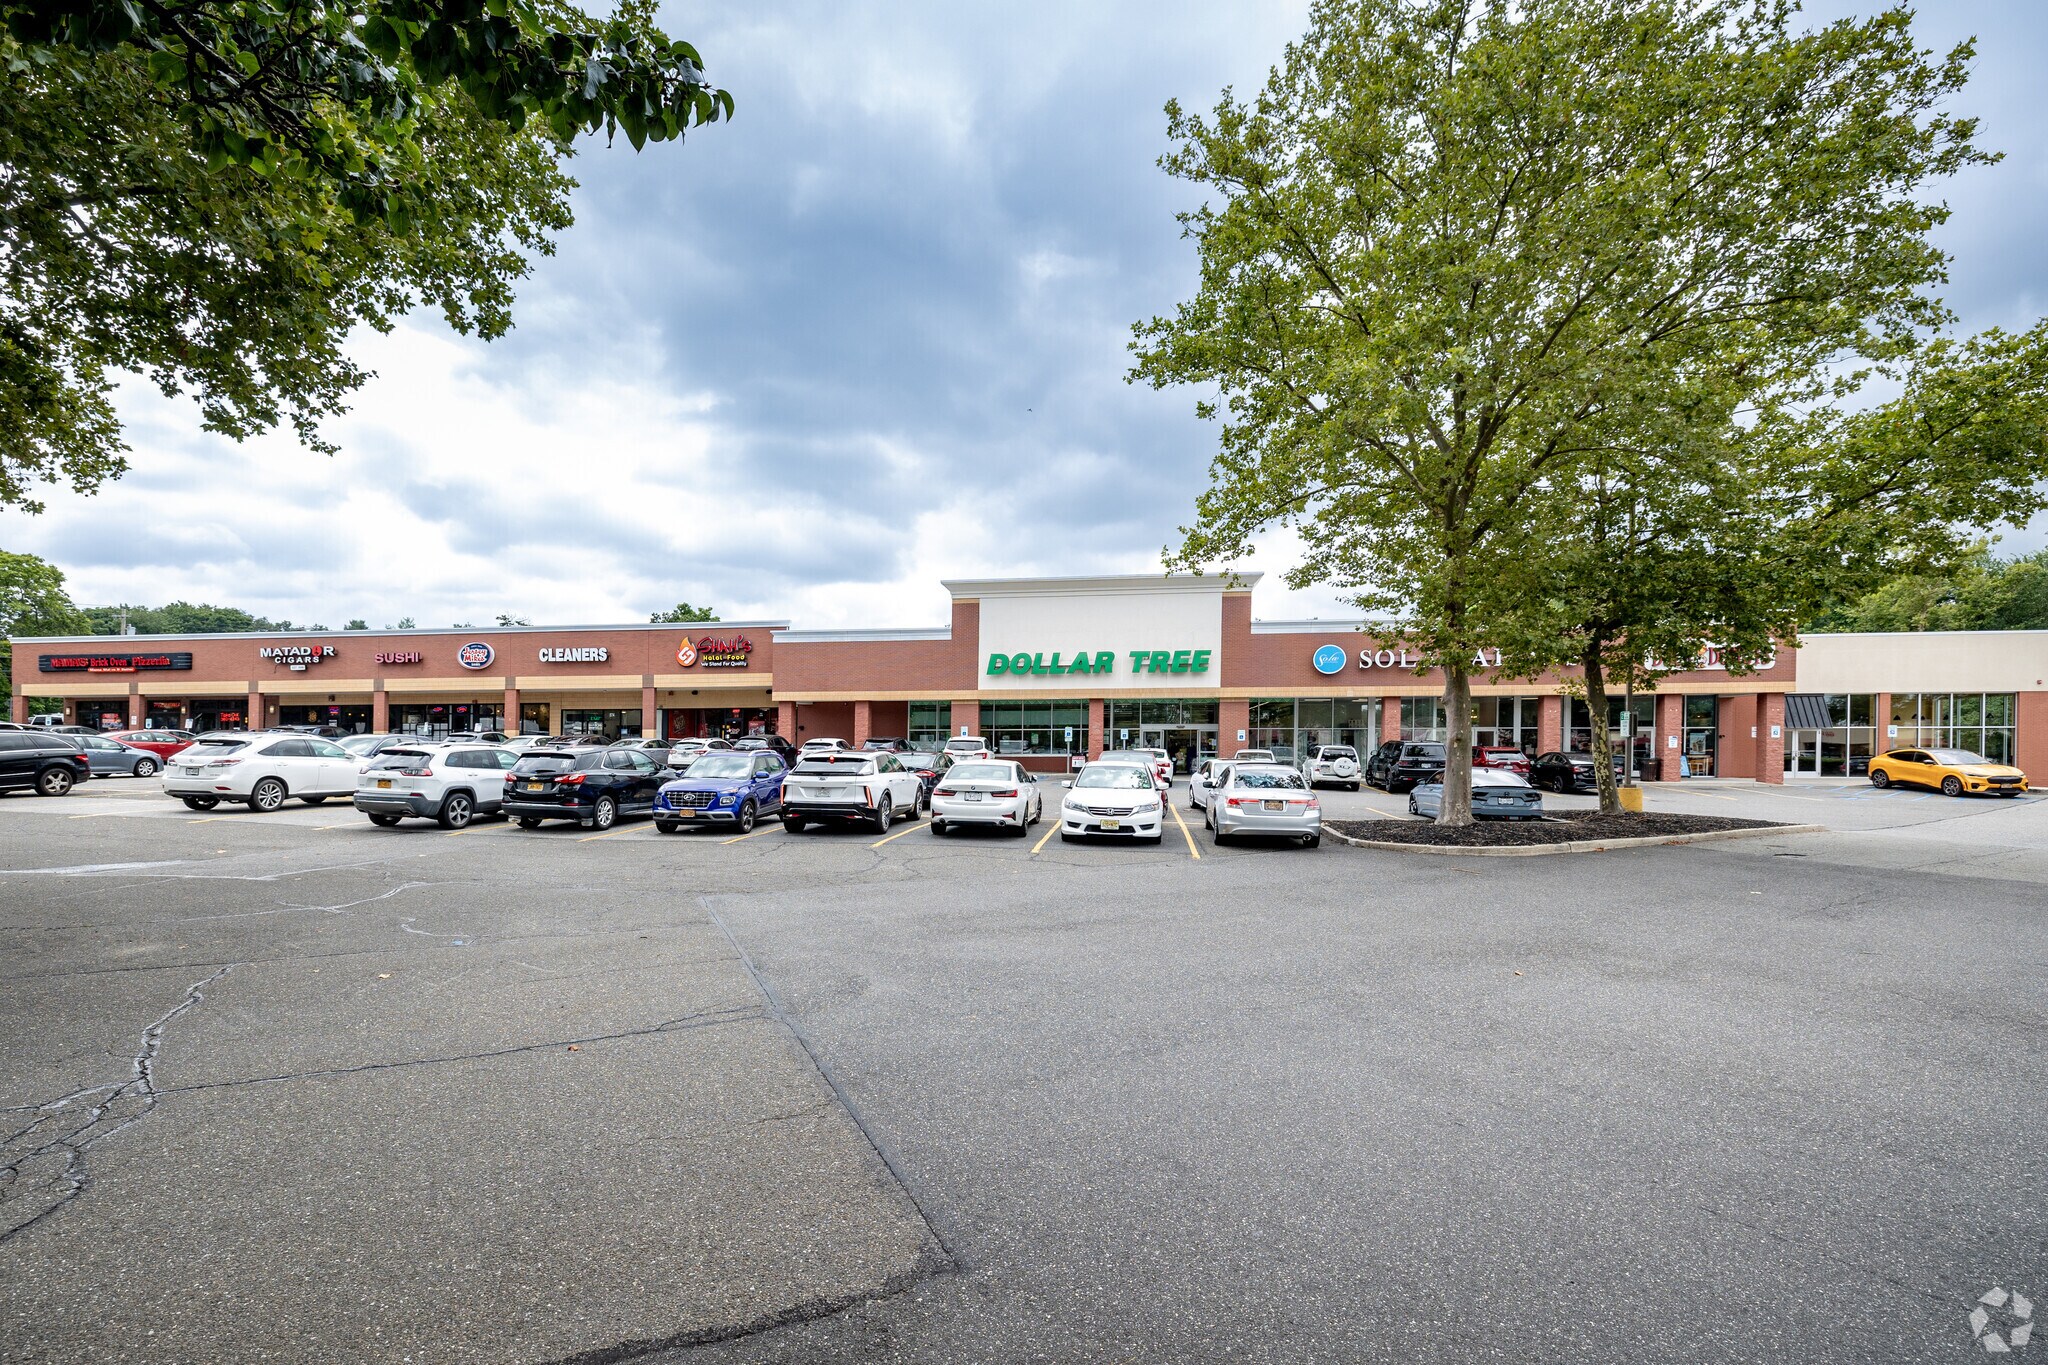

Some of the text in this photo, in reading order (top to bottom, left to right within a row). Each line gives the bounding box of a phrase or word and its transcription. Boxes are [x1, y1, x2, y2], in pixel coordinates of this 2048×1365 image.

[260, 646, 335, 657] MATADOR
[463, 647, 487, 656] Jersey
[539, 647, 608, 662] CLEANERS
[90, 658, 109, 667] Brick
[110, 658, 127, 667] Oven
[132, 656, 170, 666] Pizzeria
[375, 652, 419, 663] SUSHI
[986, 650, 1212, 675] DOLLAR TREE
[1317, 652, 1339, 667] Sola
